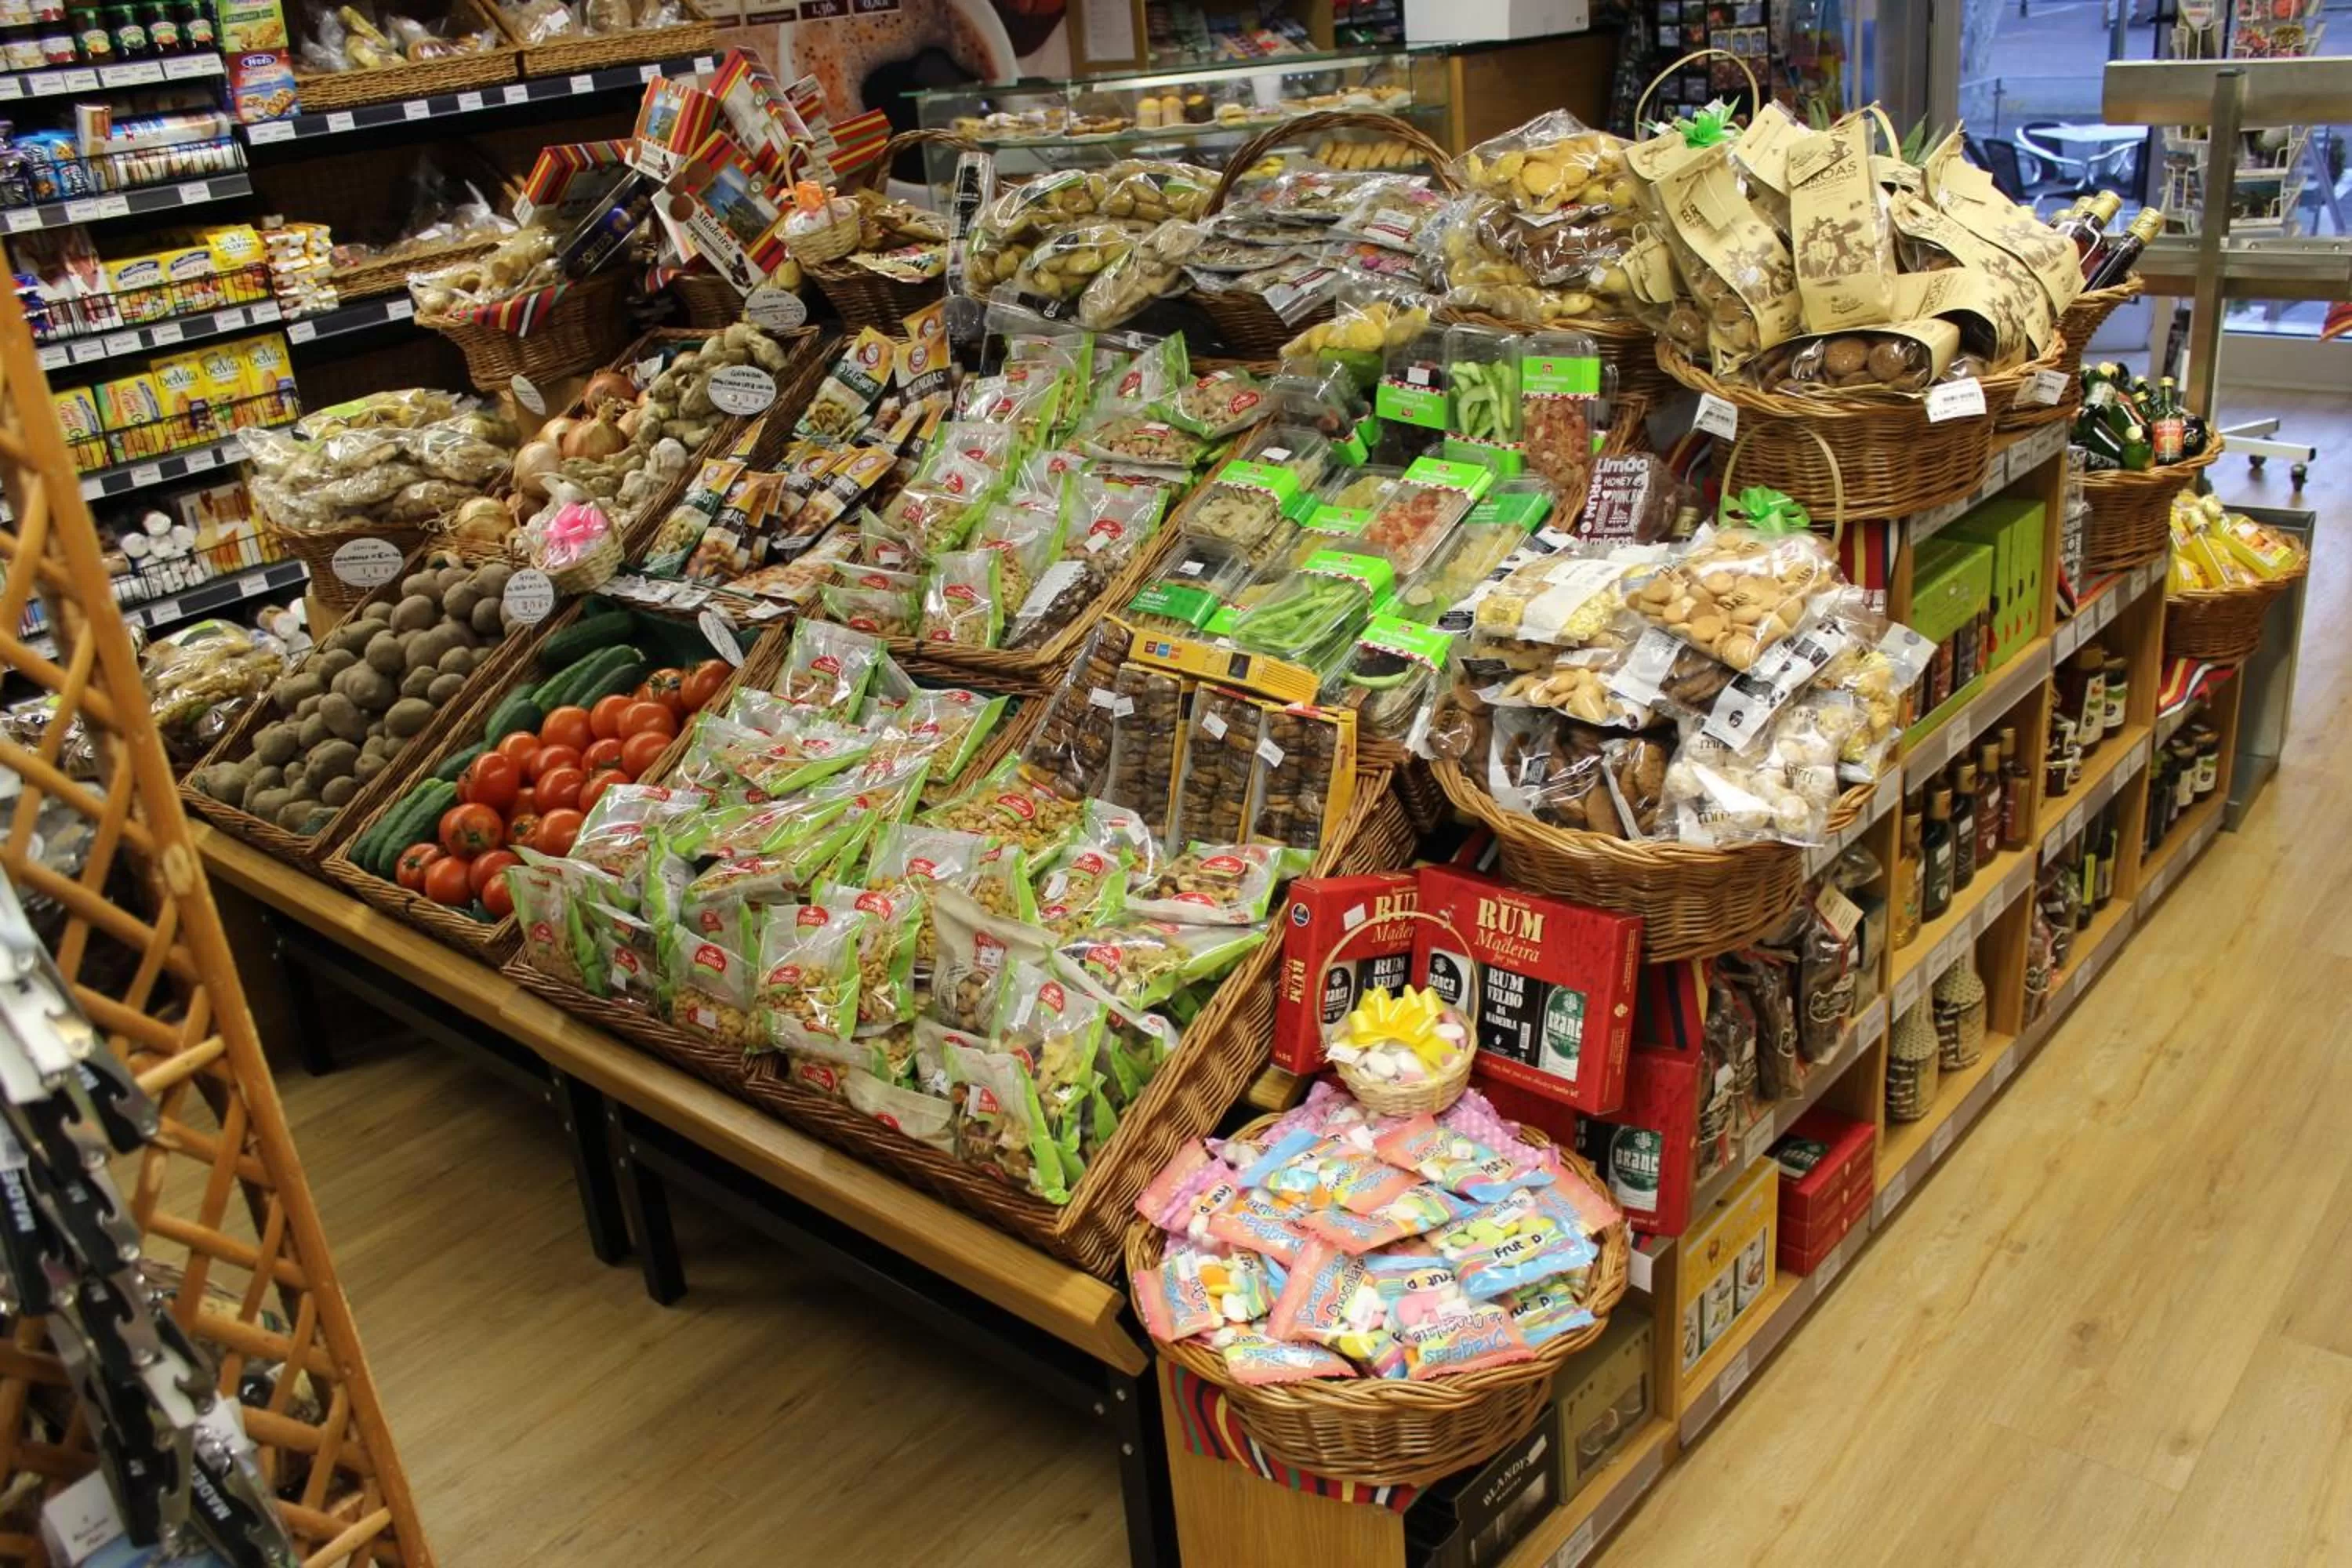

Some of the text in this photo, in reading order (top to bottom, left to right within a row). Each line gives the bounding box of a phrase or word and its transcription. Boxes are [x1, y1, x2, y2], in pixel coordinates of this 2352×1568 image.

[1806, 160, 1858, 187] ROAS
[158, 365, 199, 388] belVita
[1595, 456, 1649, 473] Limão
[1475, 897, 1546, 943] RUM
[1474, 928, 1541, 964] Madeira
[1374, 956, 1406, 975] RUM
[1489, 967, 1526, 993] RUM
[1486, 985, 1524, 1009] VELHO
[1486, 1011, 1519, 1031] MADEIRA
[1509, 1302, 1530, 1320] rut
